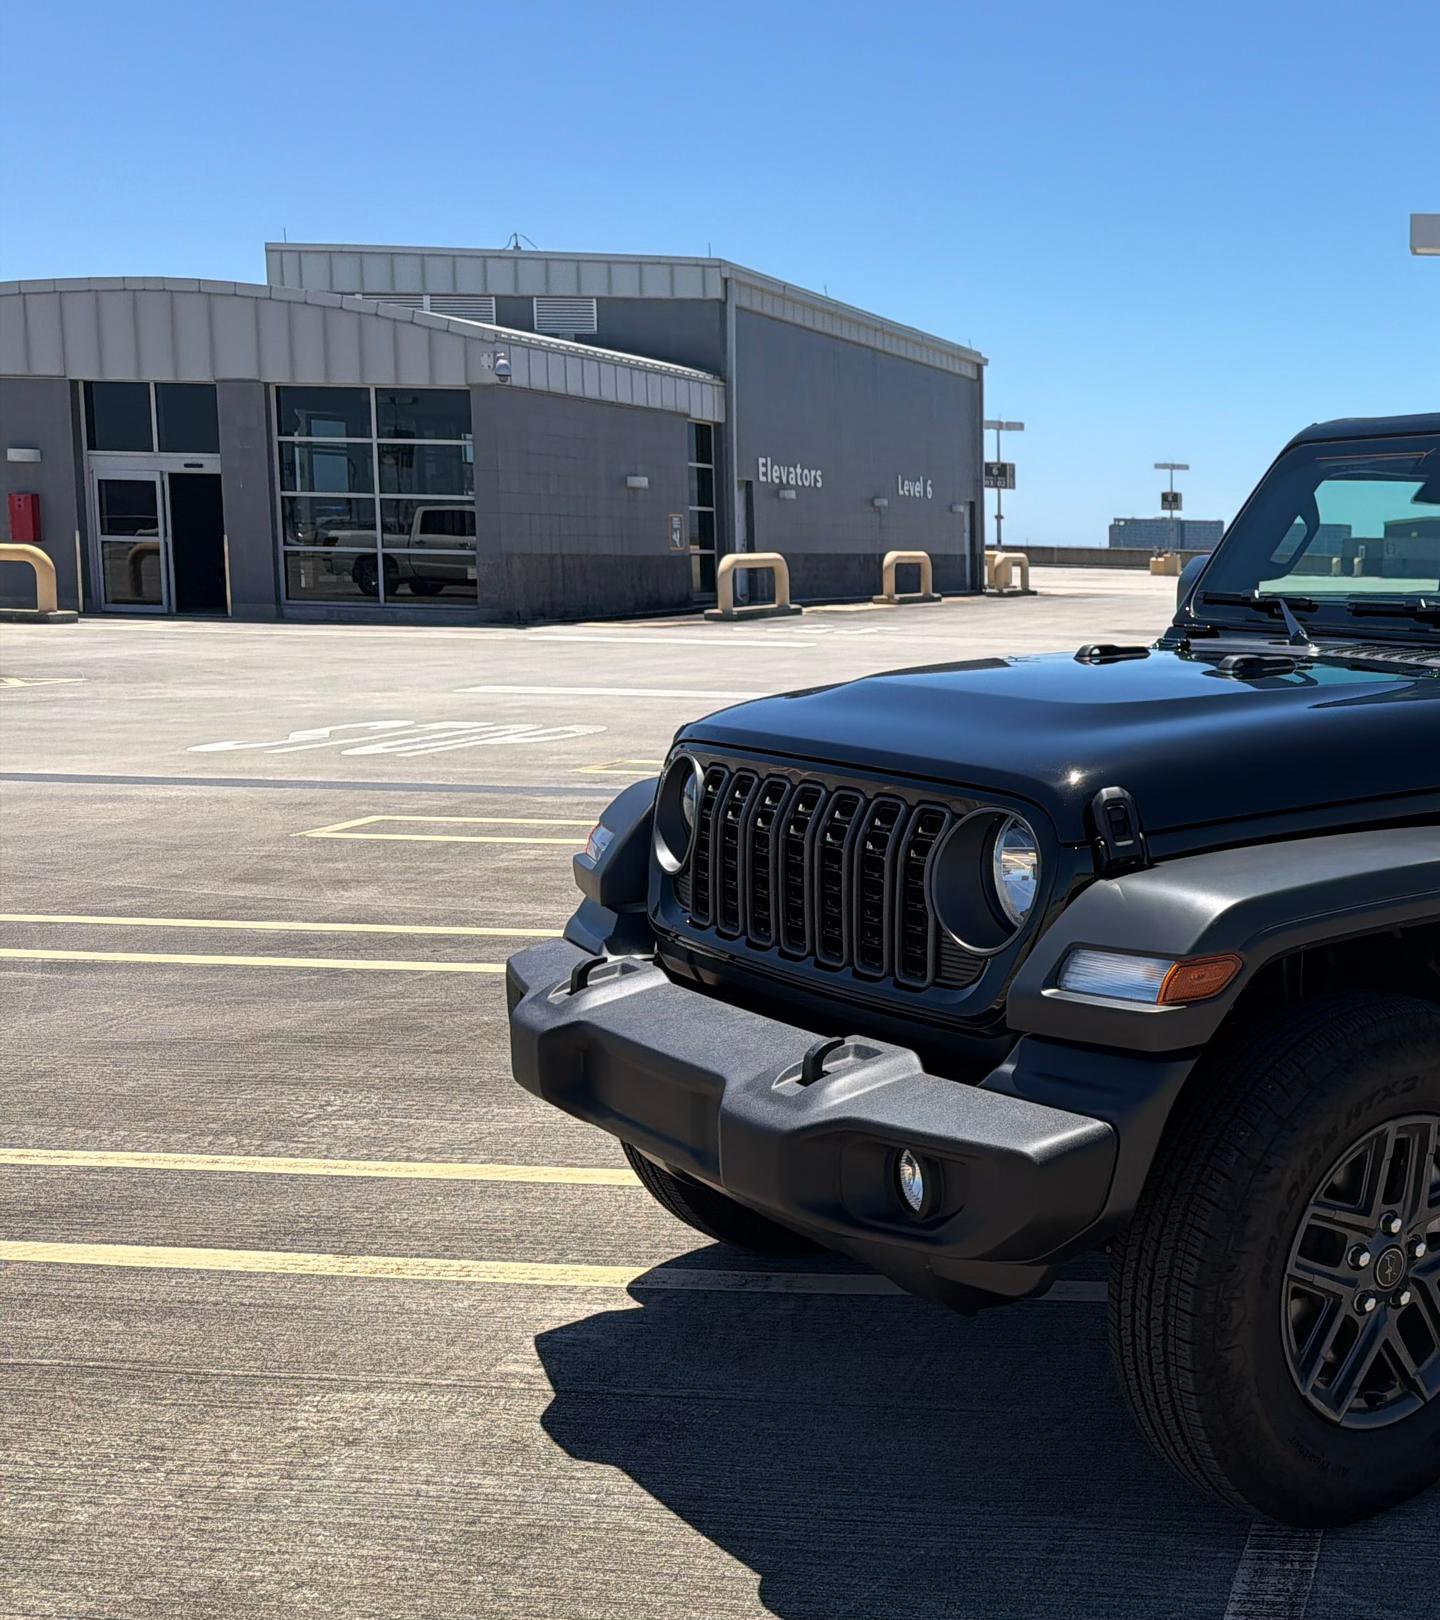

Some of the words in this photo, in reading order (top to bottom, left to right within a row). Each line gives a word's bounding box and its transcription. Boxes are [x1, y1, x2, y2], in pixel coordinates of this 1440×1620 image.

[758, 457, 823, 488] Elevators
[898, 475, 924, 498] Level
[926, 480, 933, 500] 6
[186, 719, 608, 757] STOP
